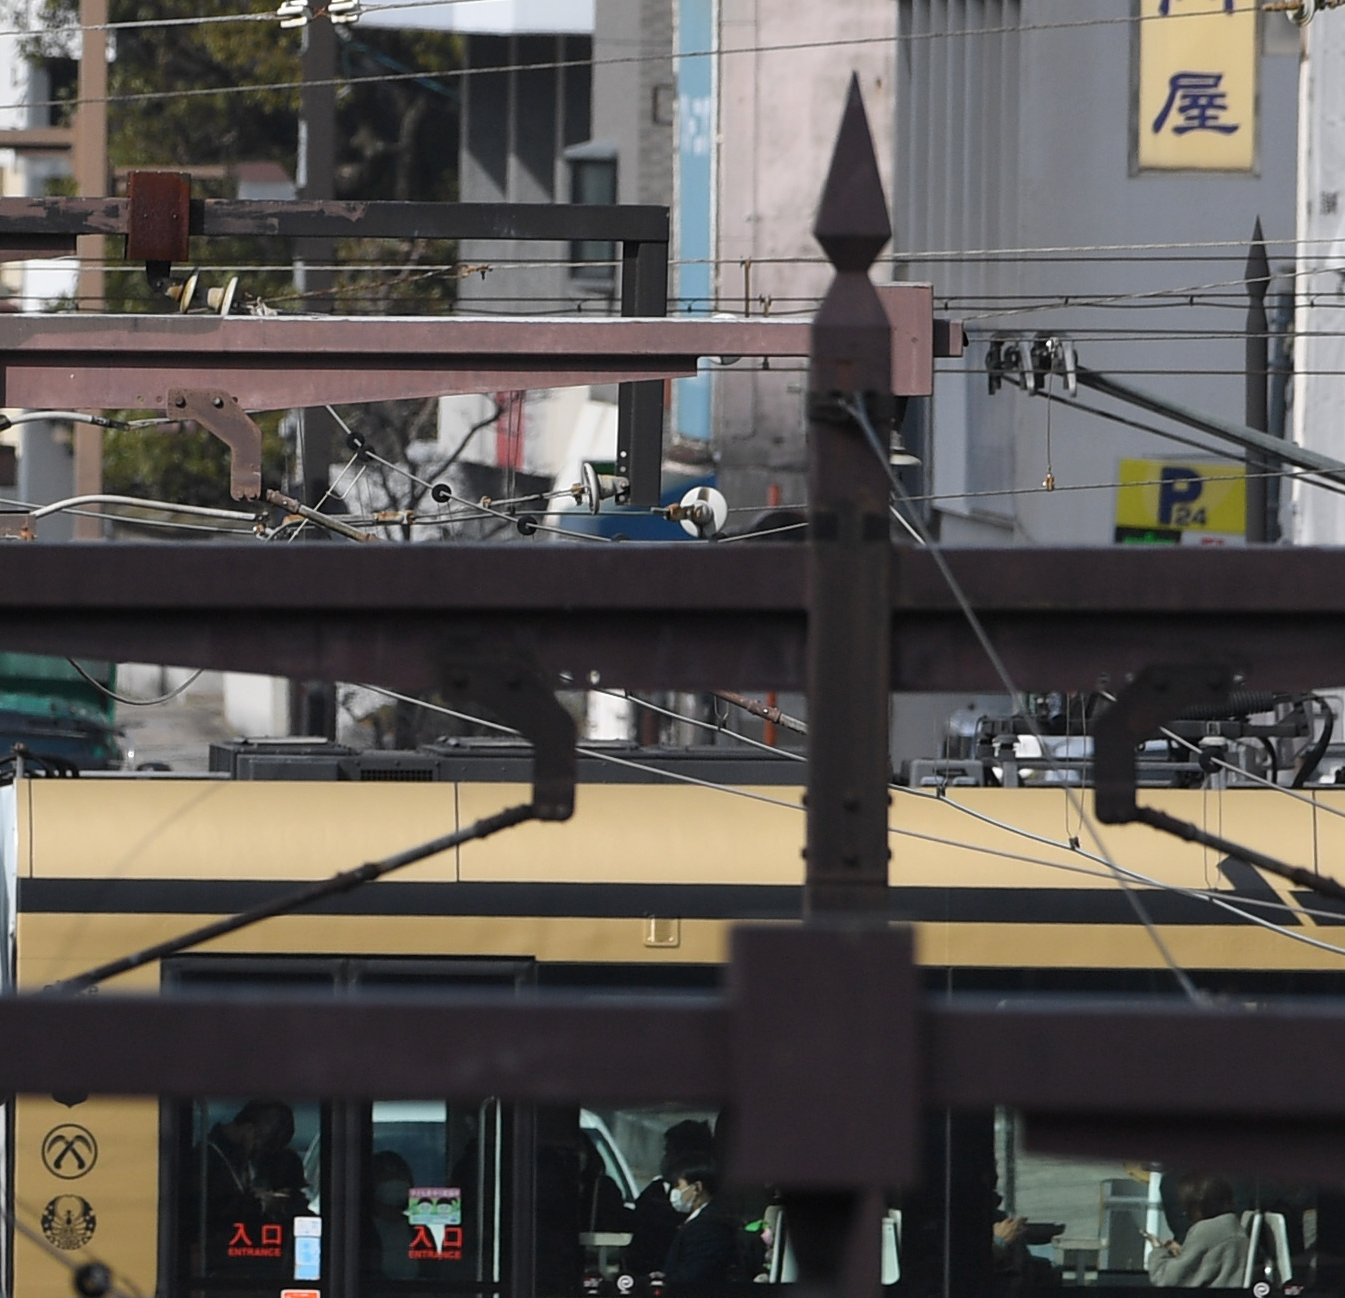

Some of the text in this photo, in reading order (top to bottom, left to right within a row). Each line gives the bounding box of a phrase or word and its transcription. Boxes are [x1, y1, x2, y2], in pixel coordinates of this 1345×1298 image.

[1158, 466, 1202, 525] P
[228, 1222, 283, 1247] 入口
[410, 1225, 463, 1249] 入口
[227, 1247, 283, 1258] ENTRANCE
